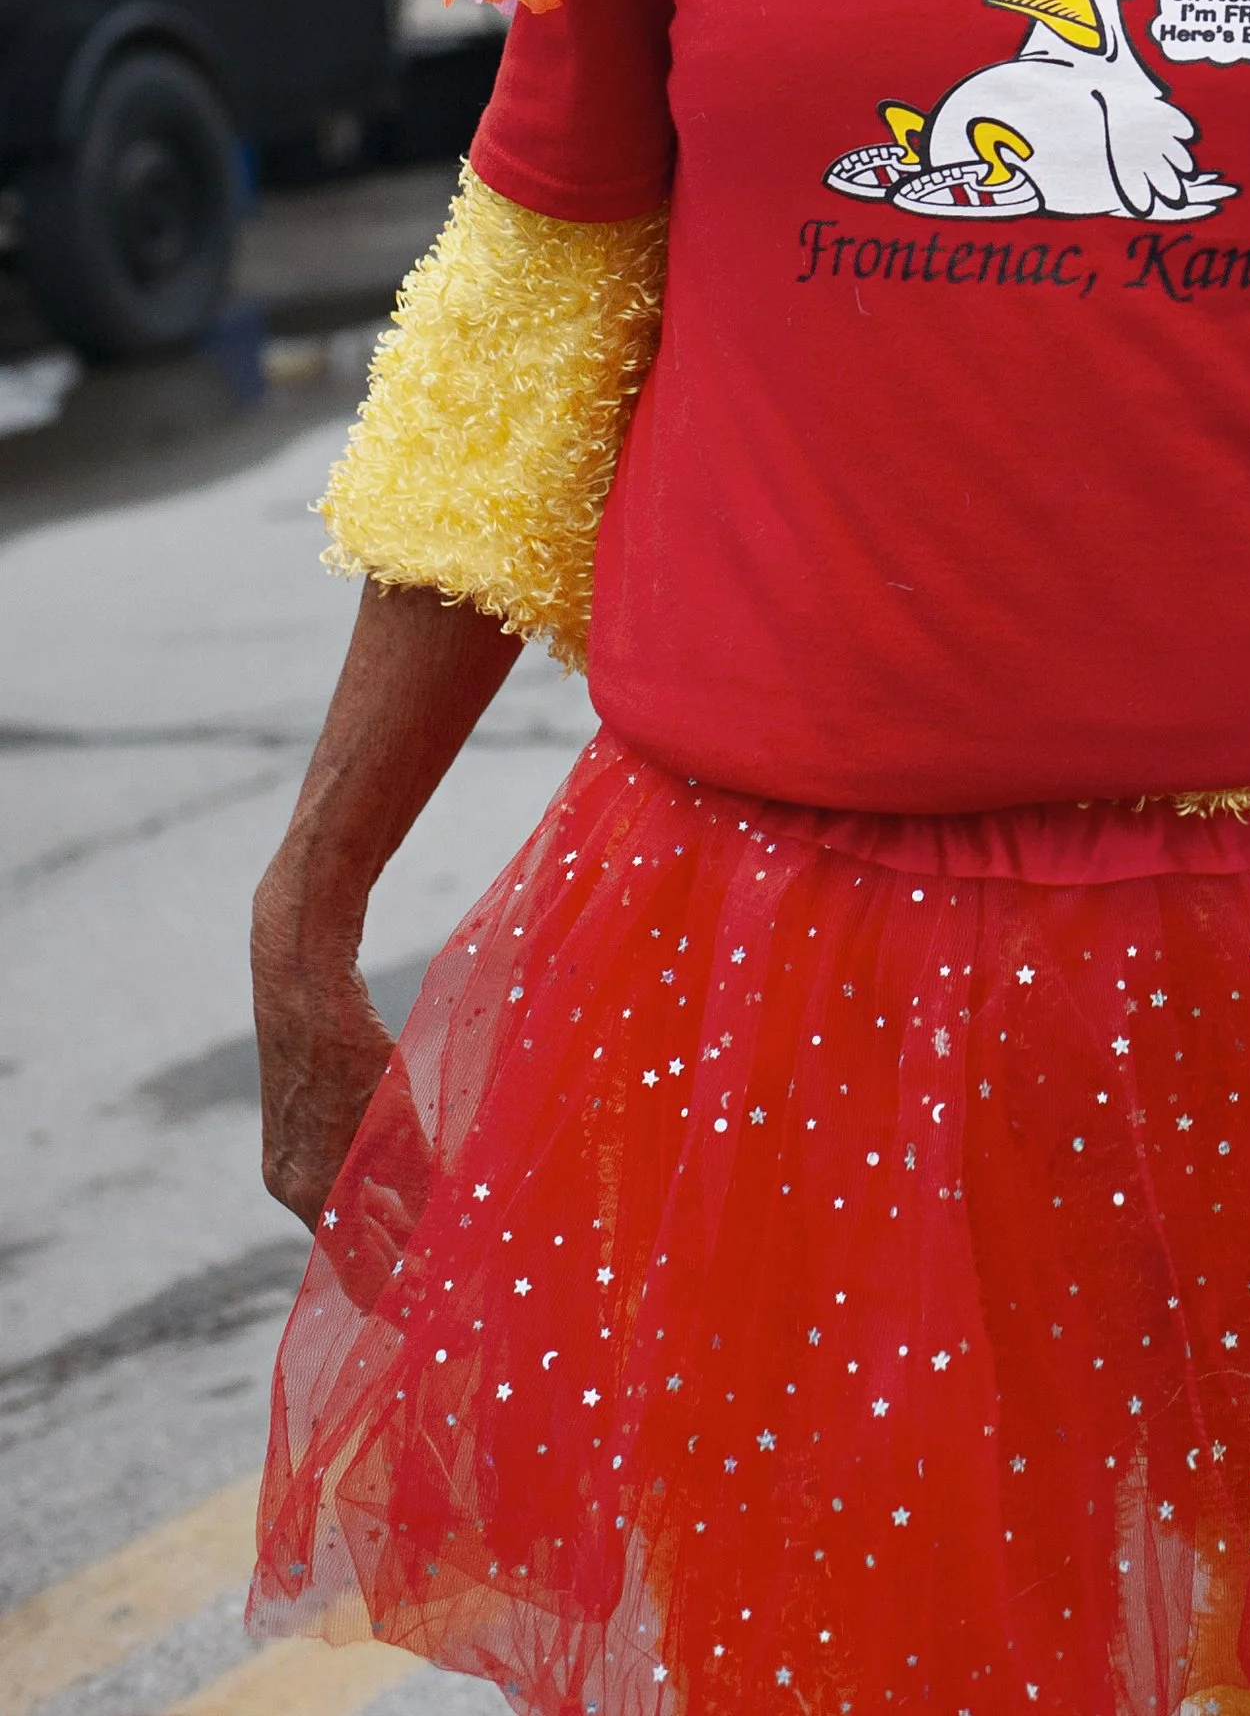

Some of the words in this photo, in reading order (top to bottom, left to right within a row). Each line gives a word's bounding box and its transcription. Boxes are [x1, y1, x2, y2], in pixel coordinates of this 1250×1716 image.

[1180, 3, 1217, 22] I'm
[1160, 24, 1235, 43] Here's
[796, 219, 1098, 298] Frontenac,
